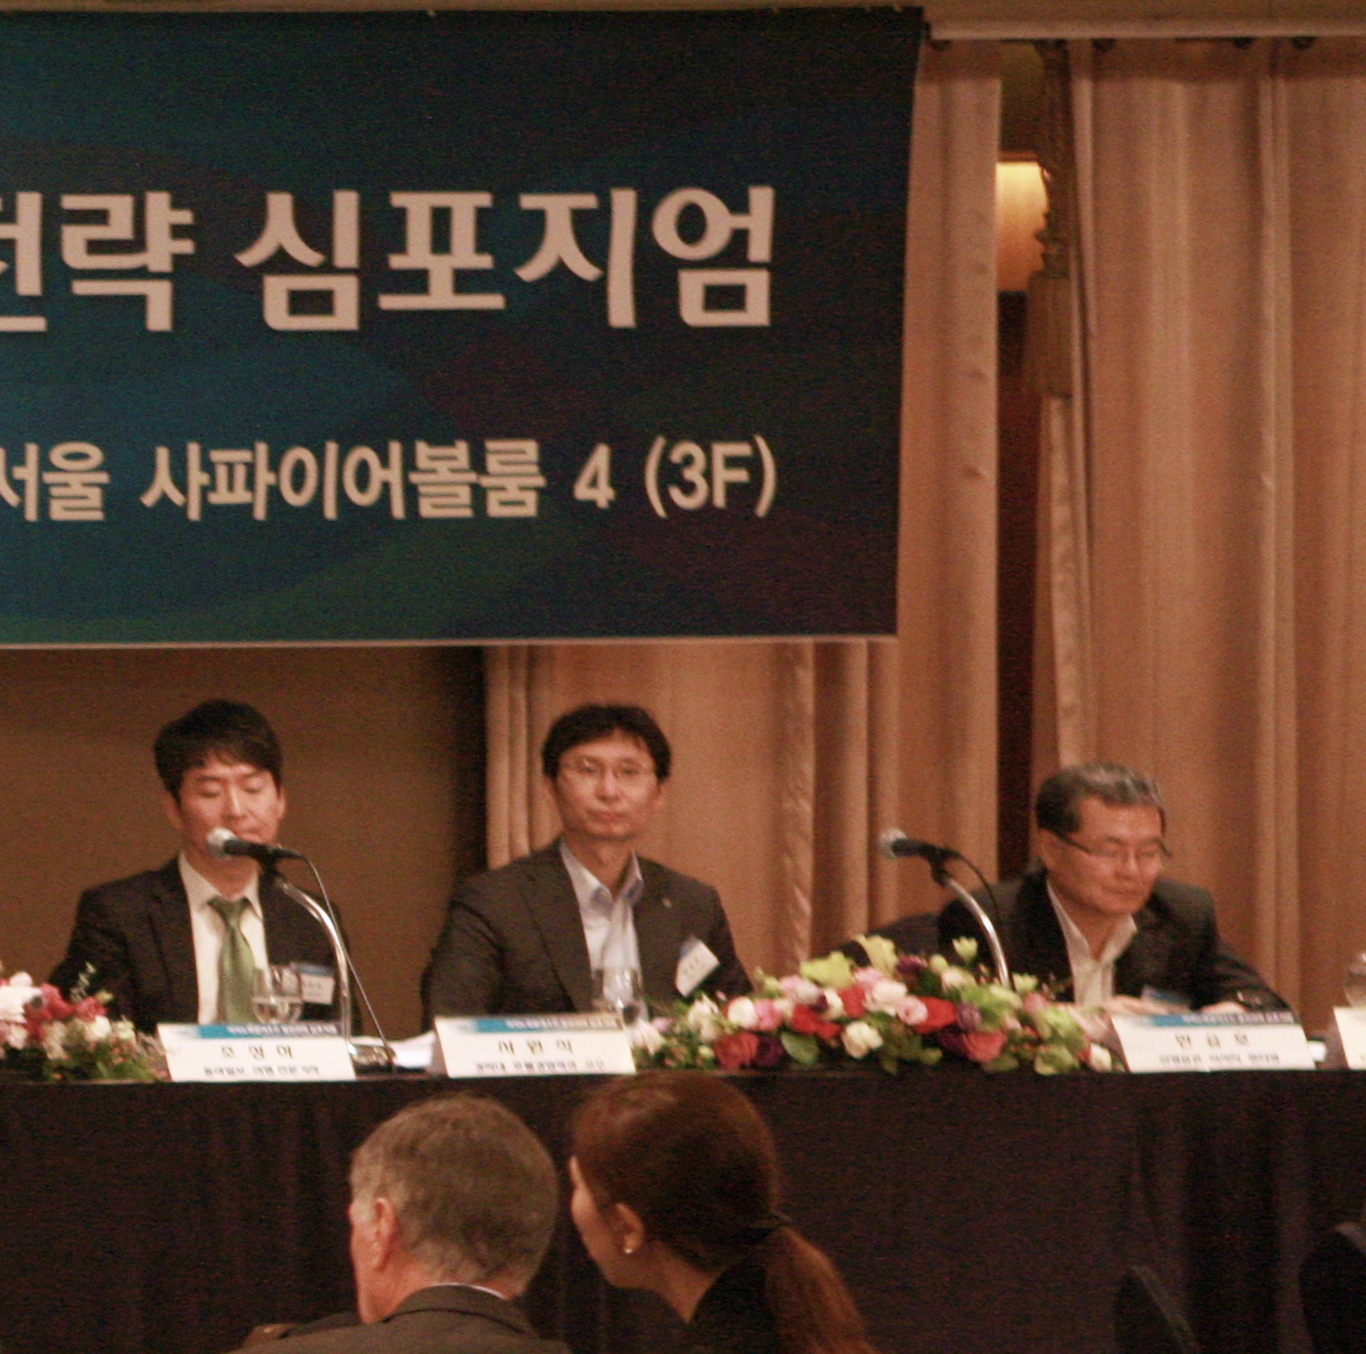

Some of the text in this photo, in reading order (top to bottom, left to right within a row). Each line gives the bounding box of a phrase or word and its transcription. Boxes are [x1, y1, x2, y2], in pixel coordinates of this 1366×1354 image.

[235, 185, 775, 330] 심포지엄
[140, 439, 547, 521] 사파이어볼룸
[573, 444, 615, 509] 4
[644, 435, 777, 517] (3F)
